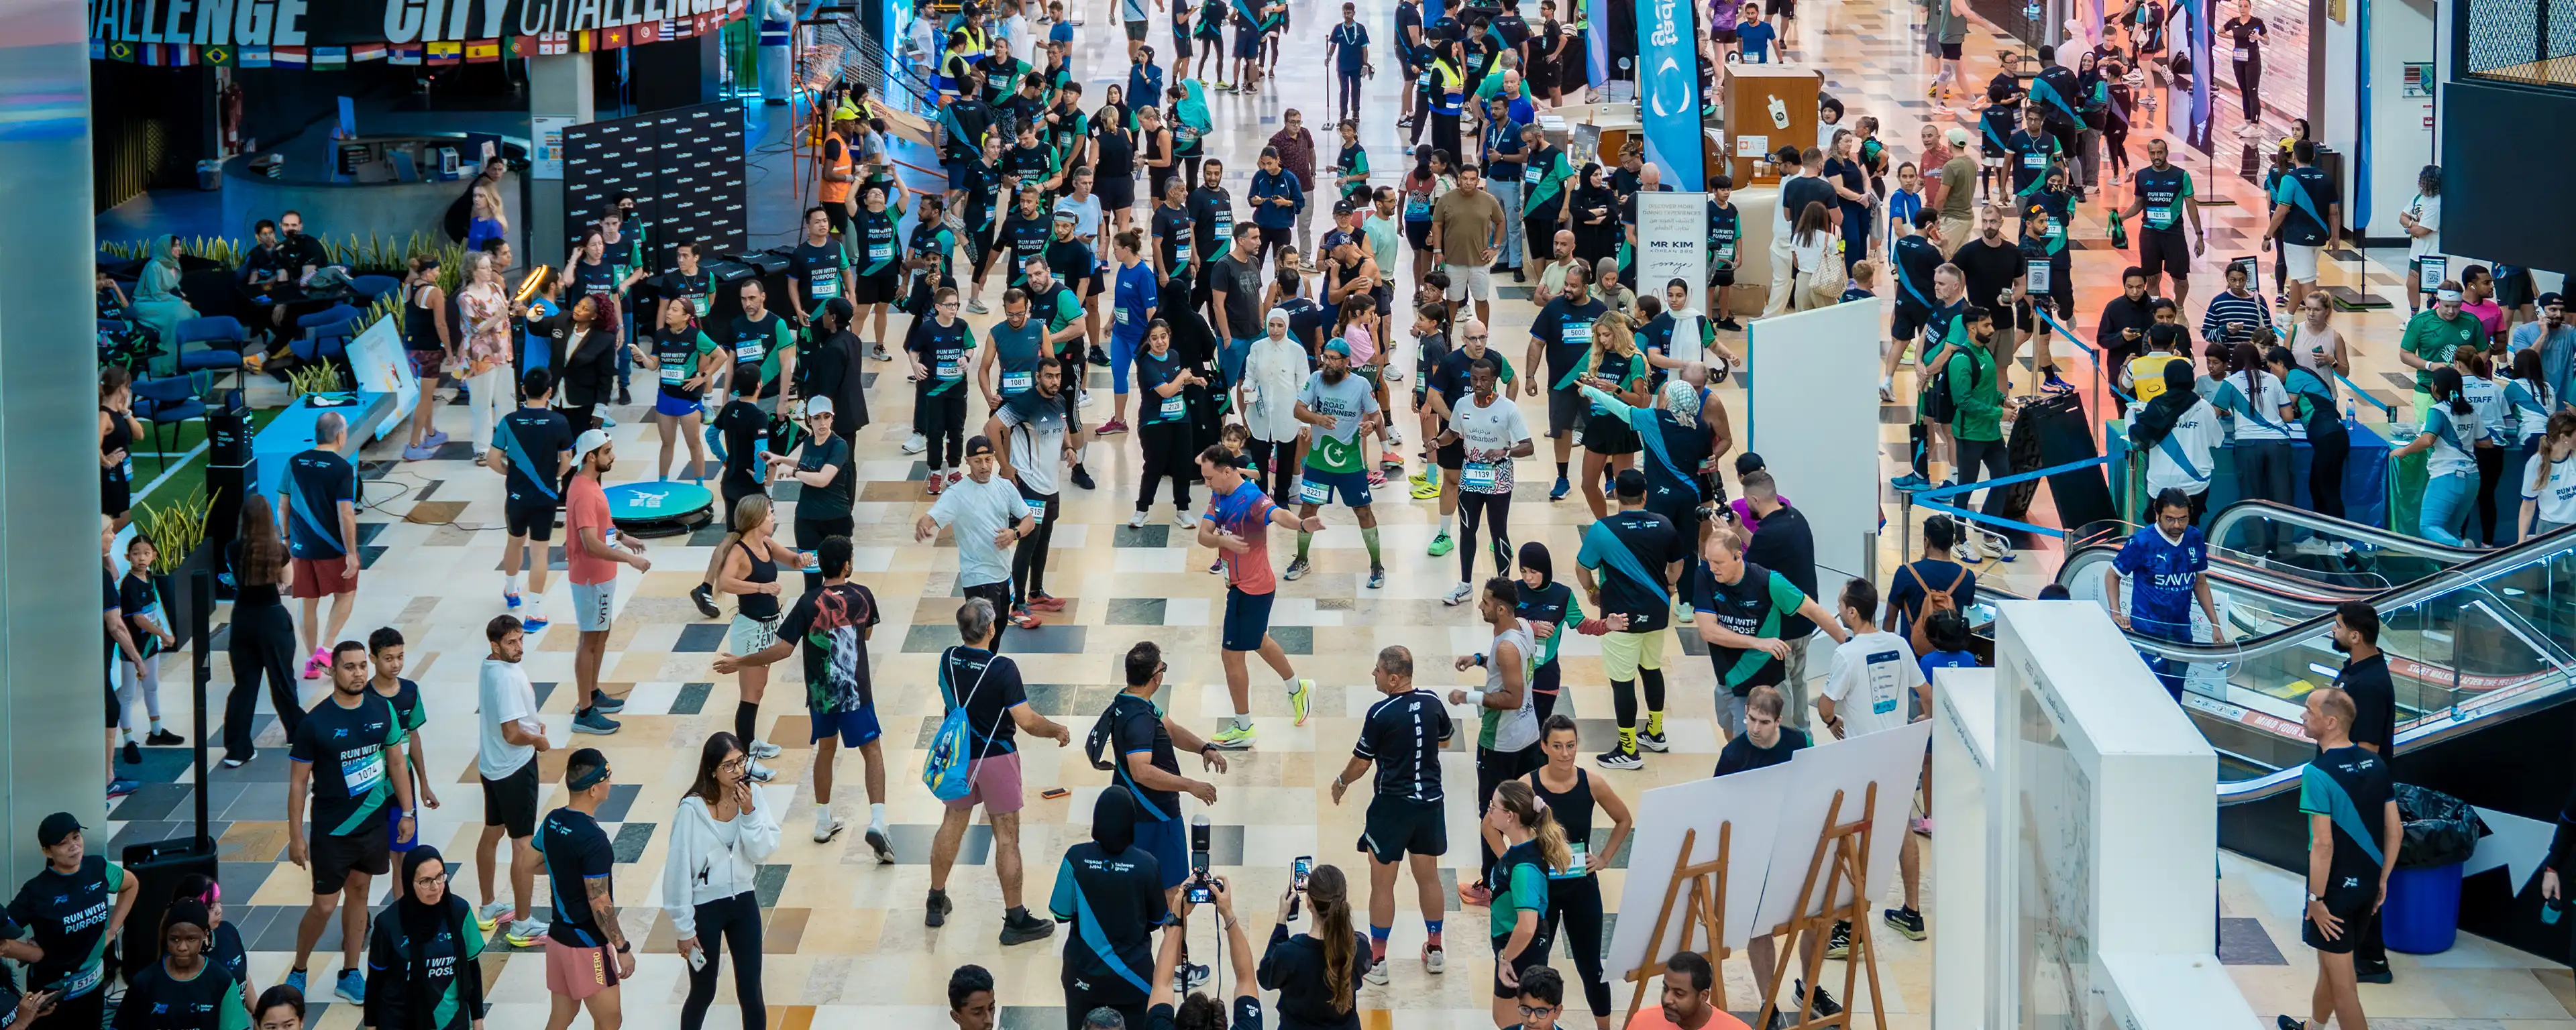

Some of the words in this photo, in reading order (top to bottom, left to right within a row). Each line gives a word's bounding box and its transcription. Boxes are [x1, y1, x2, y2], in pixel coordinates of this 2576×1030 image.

[521, 0, 727, 36] CHALLENG
[2245, 386, 2267, 394] SFF
[1323, 401, 1345, 410] ROAD
[2467, 396, 2492, 404] STAFF
[1323, 408, 1356, 418] RUNNERS
[2457, 423, 2474, 432] STAFF
[1470, 434, 1498, 443] Kharbash
[1306, 488, 1321, 498] 5221
[2556, 487, 2571, 496] RUN
[1734, 617, 1756, 626] WITH
[2407, 664, 2431, 675] START
[2430, 669, 2457, 683] WALKIN
[2254, 716, 2278, 729] MIND
[2277, 722, 2300, 735] YOUR
[1619, 732, 1632, 749] RUN
[341, 748, 360, 760] RUN
[357, 766, 378, 781] 1074
[63, 911, 84, 925] RUN
[84, 901, 106, 918] WITH
[65, 910, 107, 934] PURPOSE
[593, 951, 604, 985] ADIZERO
